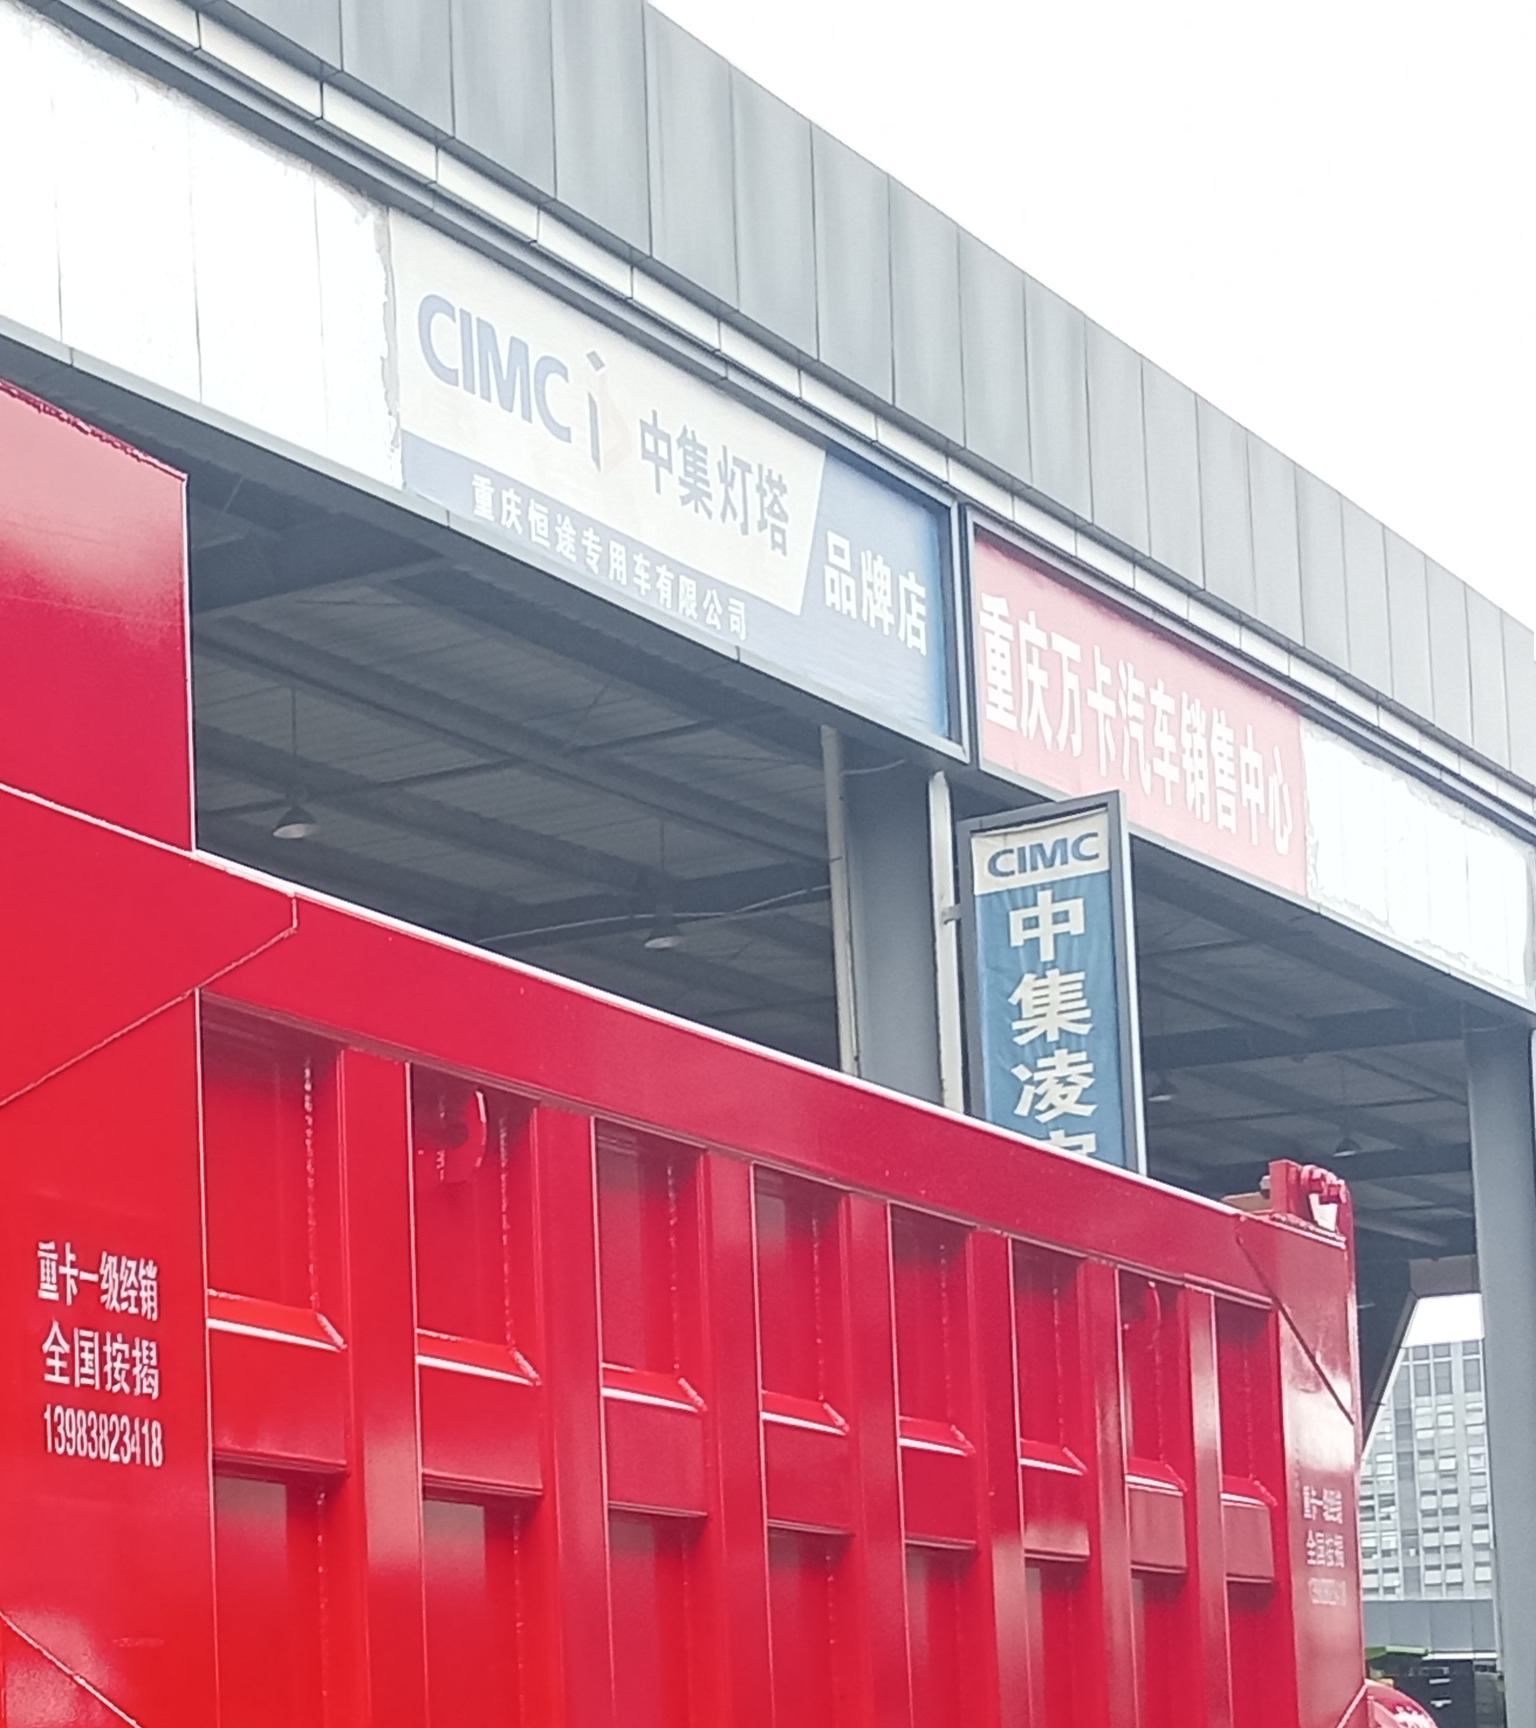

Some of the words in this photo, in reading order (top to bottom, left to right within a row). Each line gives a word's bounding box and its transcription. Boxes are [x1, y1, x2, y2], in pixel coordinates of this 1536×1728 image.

[417, 293, 572, 443] CIMC
[637, 409, 789, 558] 中集灯塔
[471, 473, 747, 641] 重庆恒途专用车有限公司
[822, 531, 928, 657] 品牌店
[979, 592, 1293, 855] 重庆万卡汽车销售中心
[987, 831, 1101, 879] CIMC
[37, 1240, 159, 1322] 重卡一级经销
[41, 1317, 160, 1401] 全国按揭
[43, 1403, 164, 1469] 13983823418
